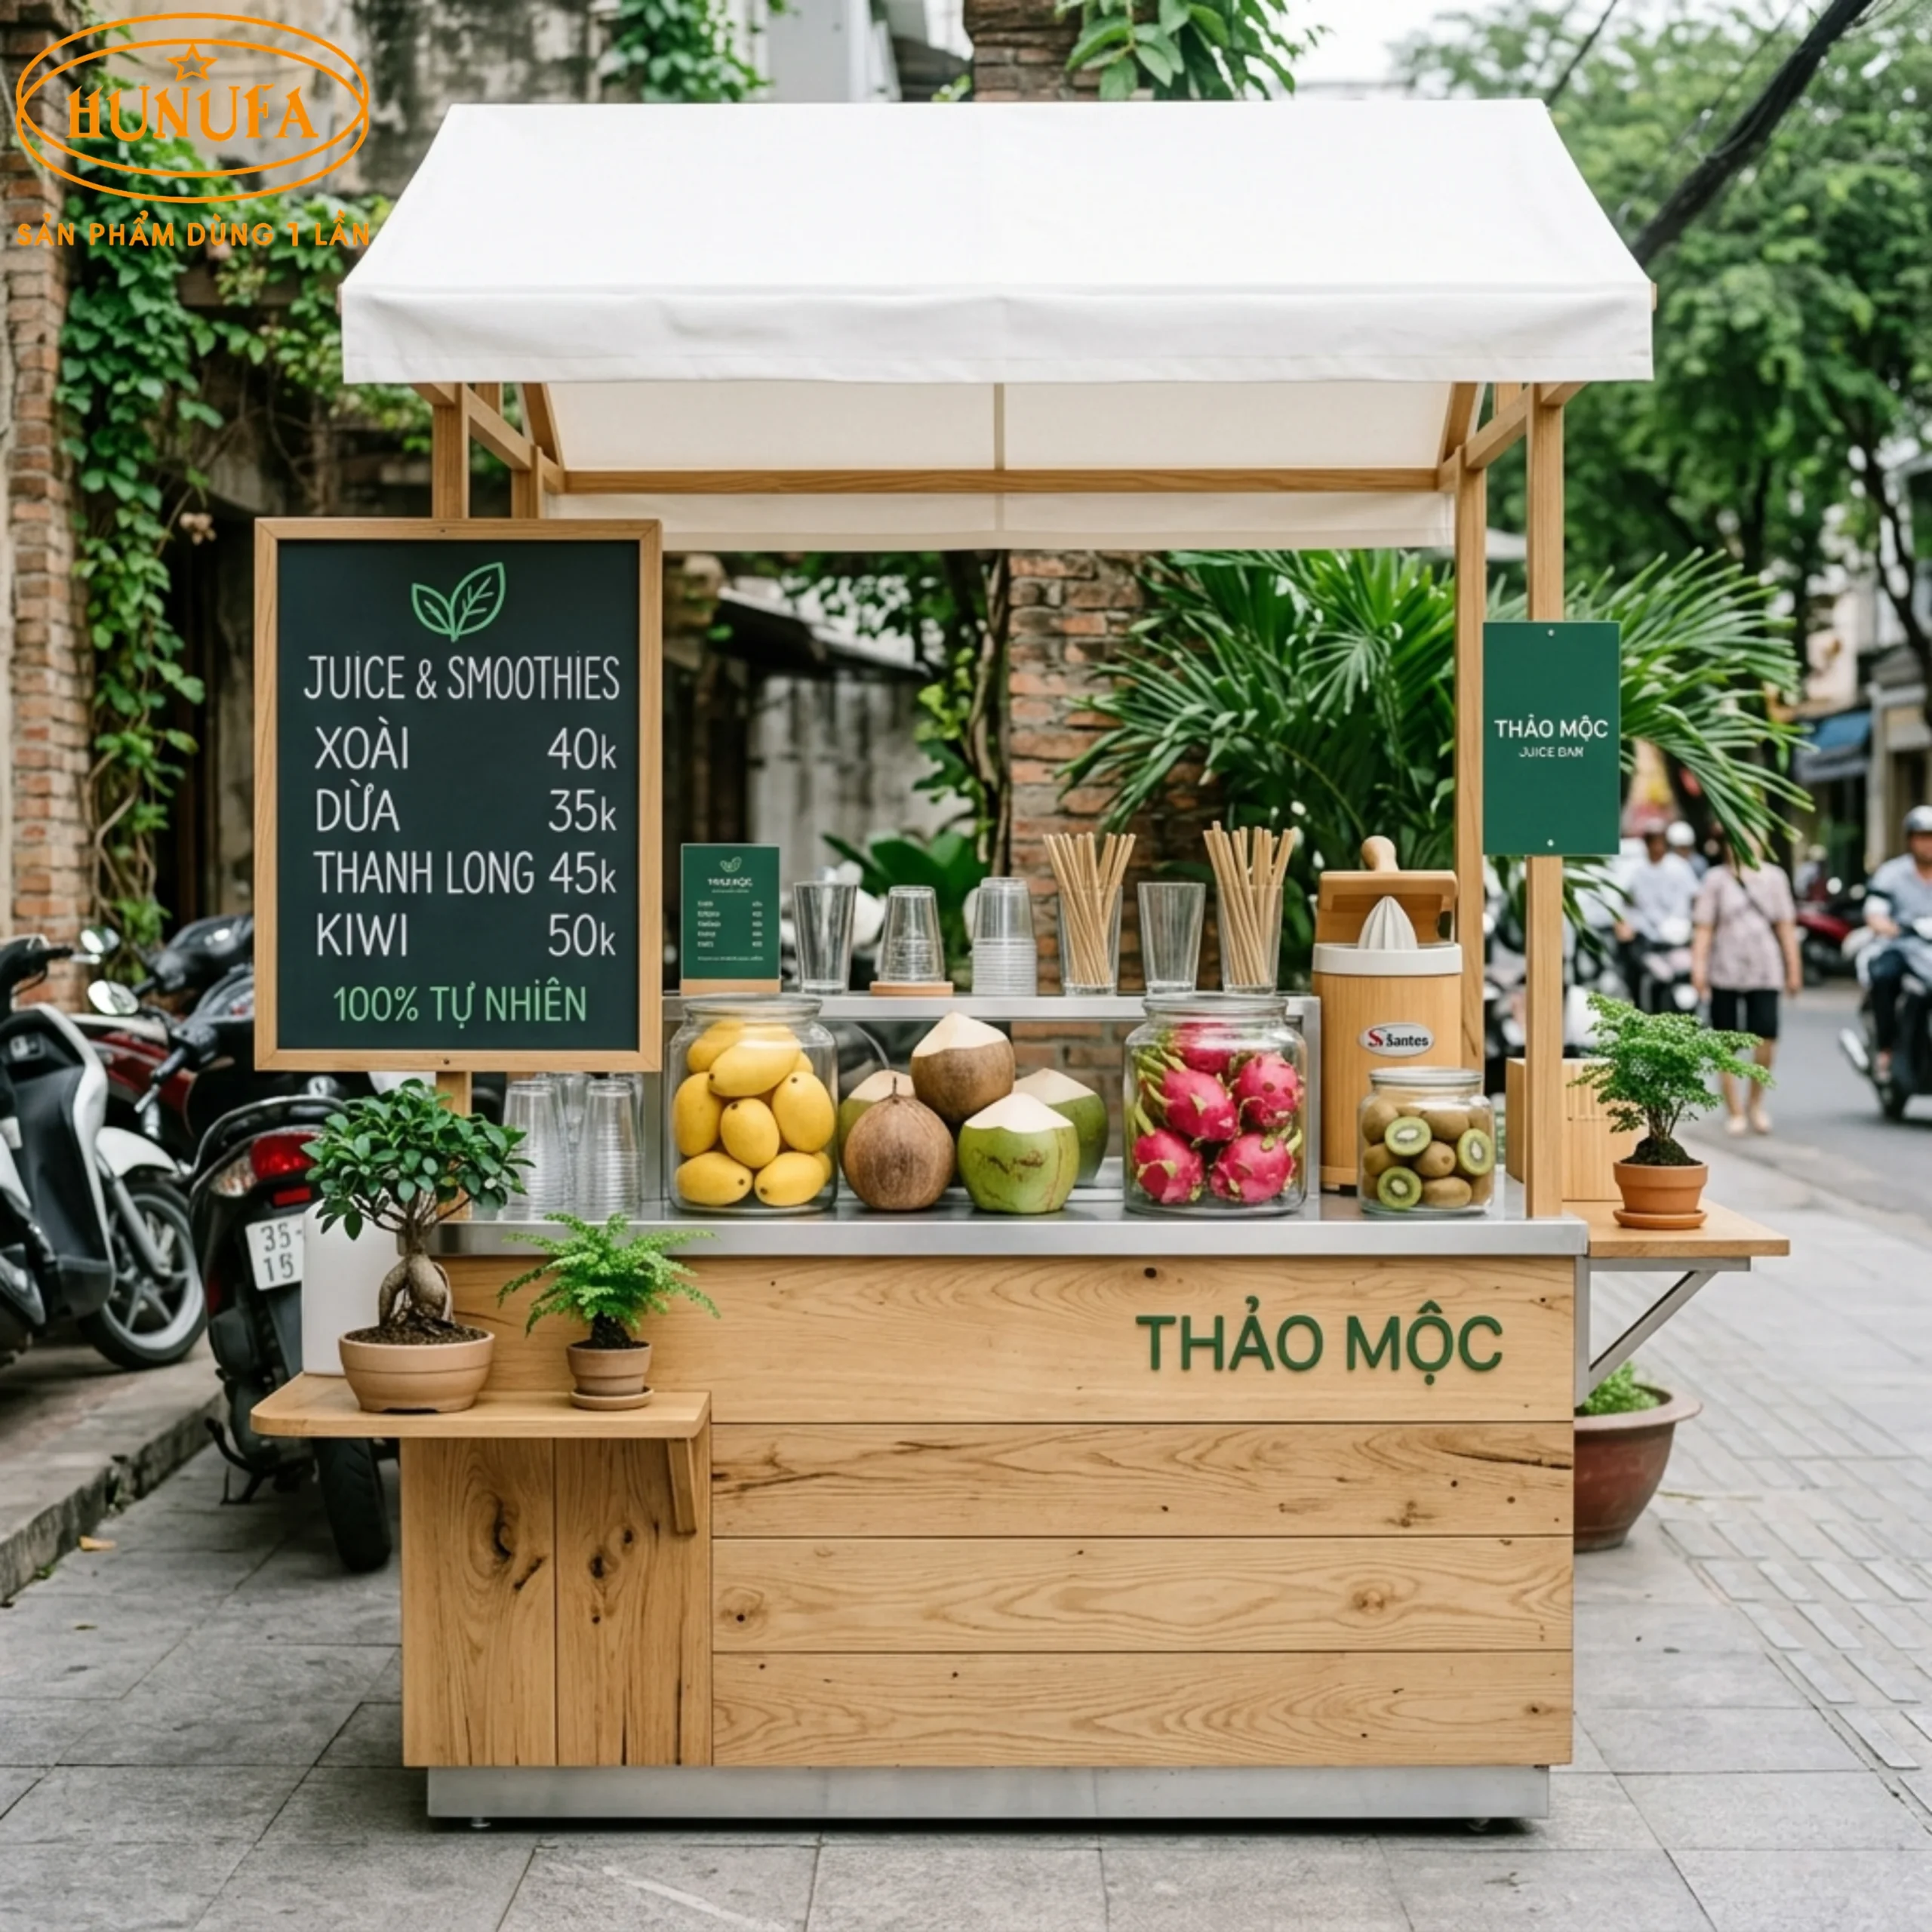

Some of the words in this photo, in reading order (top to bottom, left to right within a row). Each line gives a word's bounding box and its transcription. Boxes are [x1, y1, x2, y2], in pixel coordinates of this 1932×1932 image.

[303, 652, 405, 700] JUICE
[415, 659, 438, 700] &
[447, 651, 620, 700] SMOOTHIES
[314, 716, 409, 770] XOÀI
[547, 727, 617, 771] 40k
[1494, 713, 1555, 739] THẢO
[1559, 714, 1609, 742] MỘC
[316, 778, 401, 832] DỪA
[548, 789, 617, 832] 35k
[312, 851, 433, 894] THANH
[447, 851, 535, 895] LONG
[548, 851, 617, 894] 45k
[317, 912, 408, 957] KIWI
[548, 912, 617, 957] 50k
[333, 986, 420, 1022] 100%
[429, 980, 476, 1029] TỰ
[485, 977, 586, 1022] NHIÊN
[1135, 1295, 1324, 1372] THẢO
[1346, 1299, 1503, 1386] MỘC
